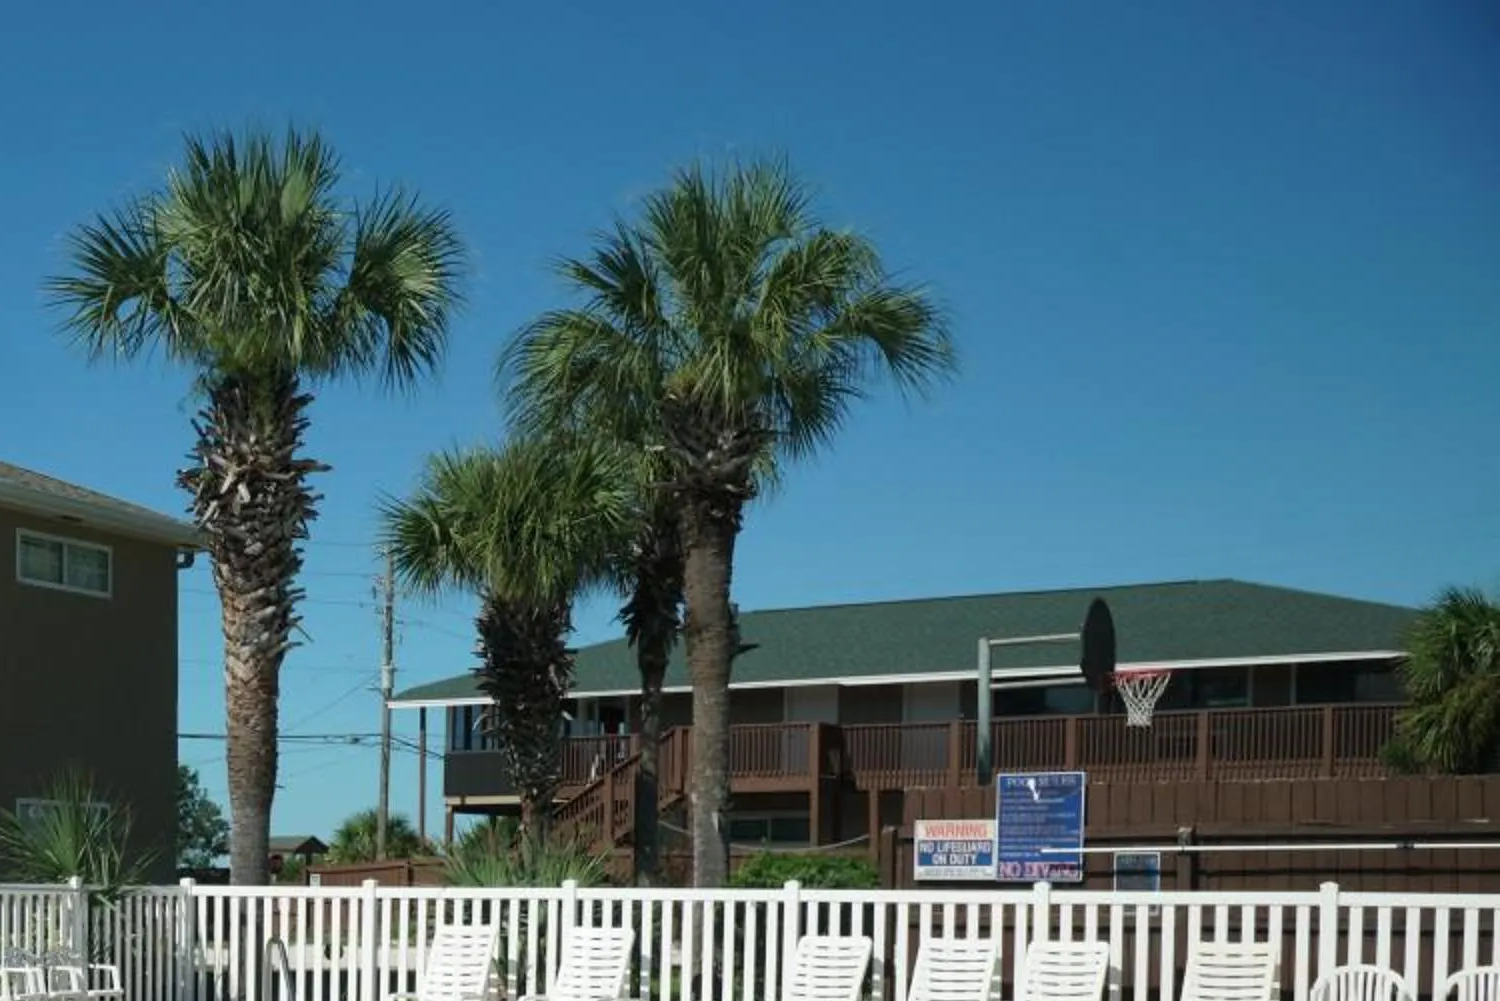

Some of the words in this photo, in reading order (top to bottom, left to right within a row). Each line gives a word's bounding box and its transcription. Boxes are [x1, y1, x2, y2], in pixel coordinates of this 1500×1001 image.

[925, 822, 988, 838] WARNING
[918, 840, 935, 852] NO
[937, 839, 991, 853] LIFEGUARD
[932, 853, 946, 865] ON
[948, 853, 977, 865] DUTY
[999, 862, 1020, 878] NO
